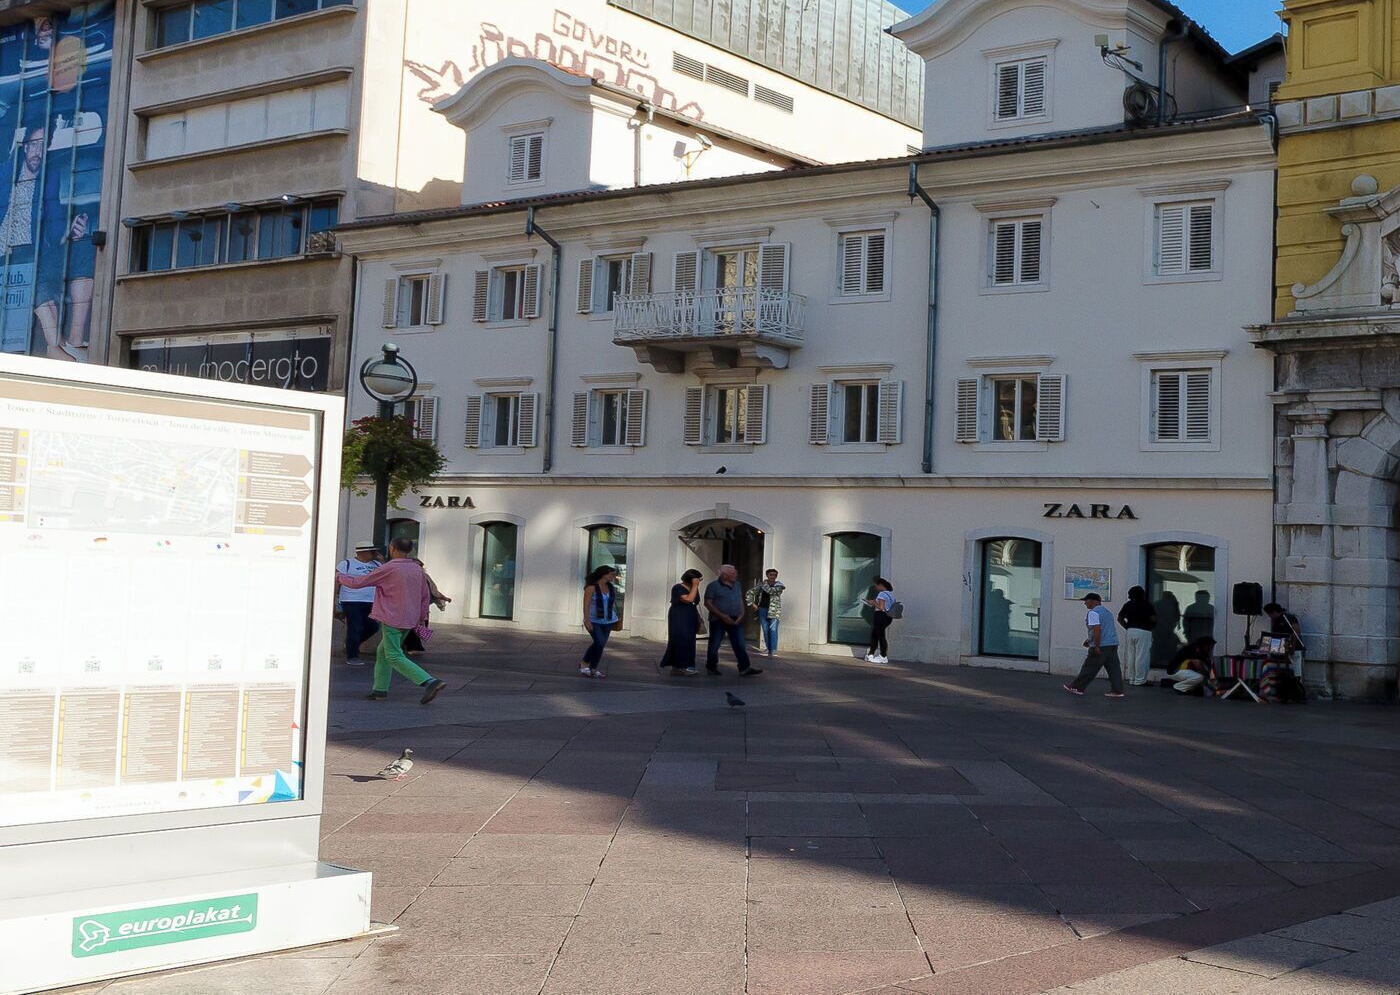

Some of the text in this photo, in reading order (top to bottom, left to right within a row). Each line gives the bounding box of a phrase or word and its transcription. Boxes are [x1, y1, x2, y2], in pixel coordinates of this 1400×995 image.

[553, 8, 634, 59] GOVOR
[419, 495, 476, 509] ZARA
[1043, 503, 1139, 520] ZARA
[119, 904, 241, 935] europlakat
